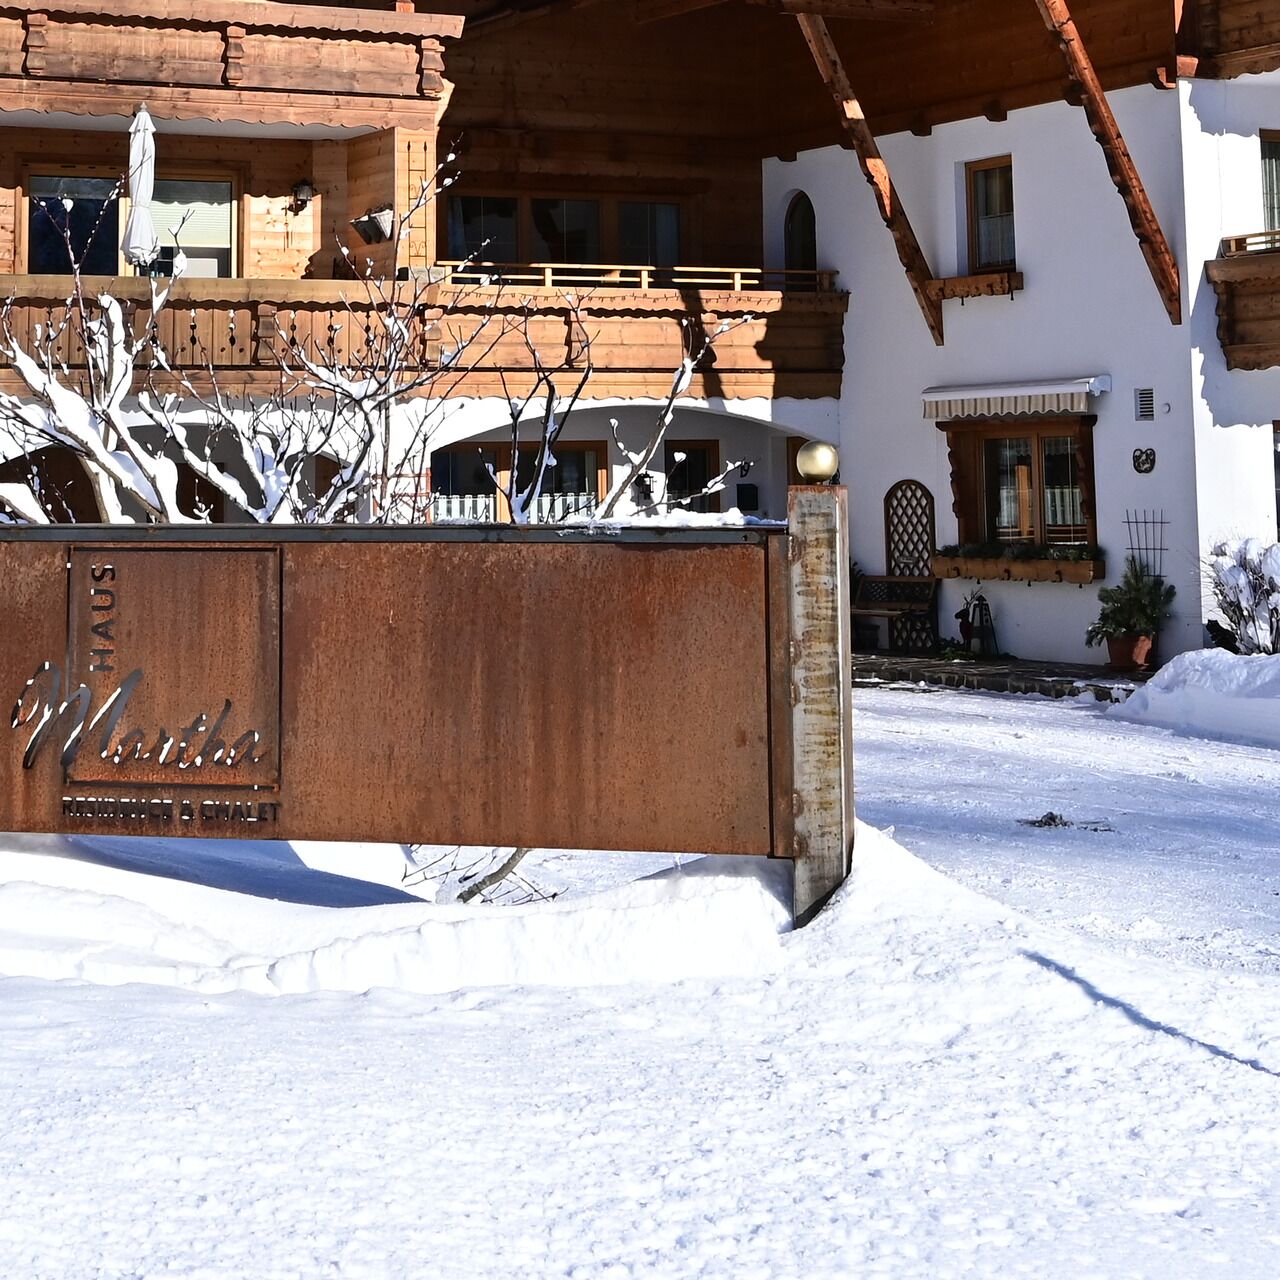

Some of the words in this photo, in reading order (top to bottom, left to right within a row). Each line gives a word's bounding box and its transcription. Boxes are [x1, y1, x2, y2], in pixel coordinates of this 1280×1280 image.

[90, 564, 116, 671] HAUS
[11, 661, 266, 769] Martha
[201, 801, 281, 822] CHALET
